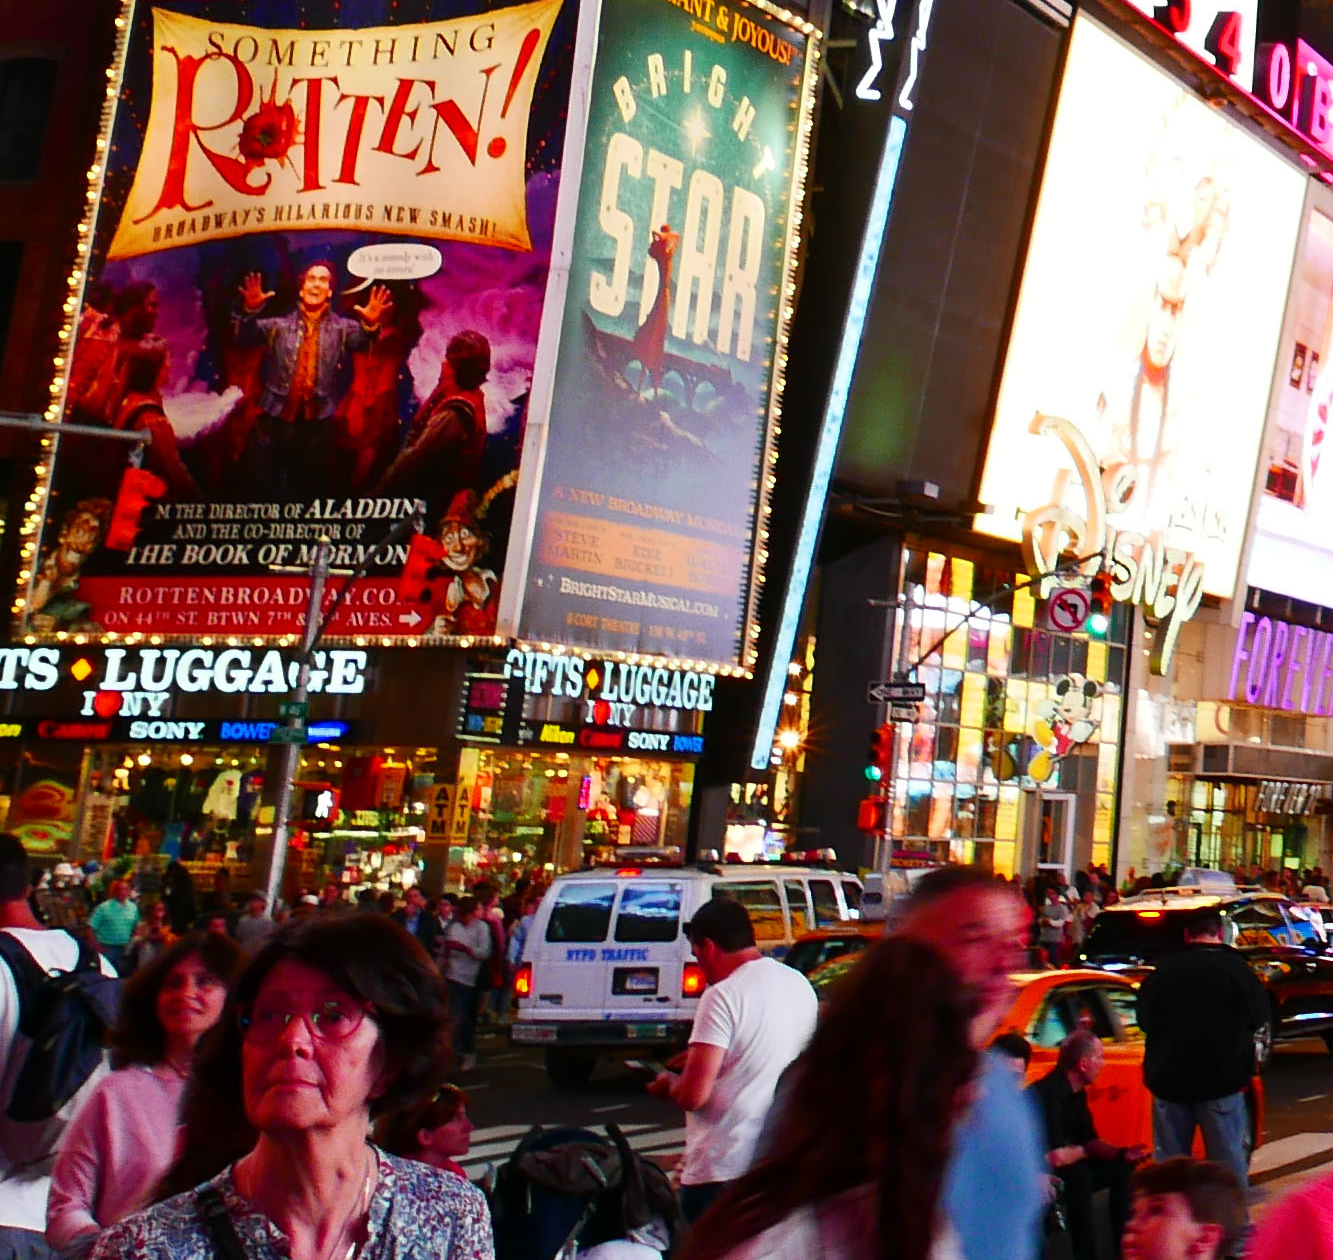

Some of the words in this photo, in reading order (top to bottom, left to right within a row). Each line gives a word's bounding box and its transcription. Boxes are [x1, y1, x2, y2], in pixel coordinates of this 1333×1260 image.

[715, 5, 729, 32] &
[204, 22, 498, 68] SOMETHING
[612, 49, 777, 181] BRIGHT
[273, 203, 375, 223] HILARIOUS
[382, 205, 420, 225] NEW
[589, 131, 766, 363] STAR
[175, 503, 205, 520] THE
[208, 503, 280, 520] DIRECTOR
[284, 503, 304, 520] OF
[304, 498, 427, 520] ALADDIN
[551, 484, 566, 500] A
[570, 487, 605, 507] NEW
[607, 496, 686, 524] BROADWAY
[173, 523, 206, 540] AND
[210, 523, 240, 540] THE
[243, 523, 341, 540] CO-DIRECTOR
[345, 523, 366, 540] OF
[556, 529, 600, 550] STEVE
[181, 543, 251, 565] BOOK
[257, 543, 293, 565] OF
[104, 610, 130, 626] ON
[207, 610, 261, 627] BTWN
[99, 648, 368, 694] LUGGAGE
[600, 660, 716, 712] LUGGAGE
[80, 690, 98, 717] I
[117, 690, 171, 718] NY
[584, 699, 596, 724] I
[608, 702, 637, 728] NY
[129, 721, 206, 740] SONY
[627, 731, 671, 751] SONY
[431, 786, 449, 834] ATM
[455, 786, 471, 834] ATM
[566, 948, 597, 962] NYPD
[601, 948, 650, 962] TRAFFIC
